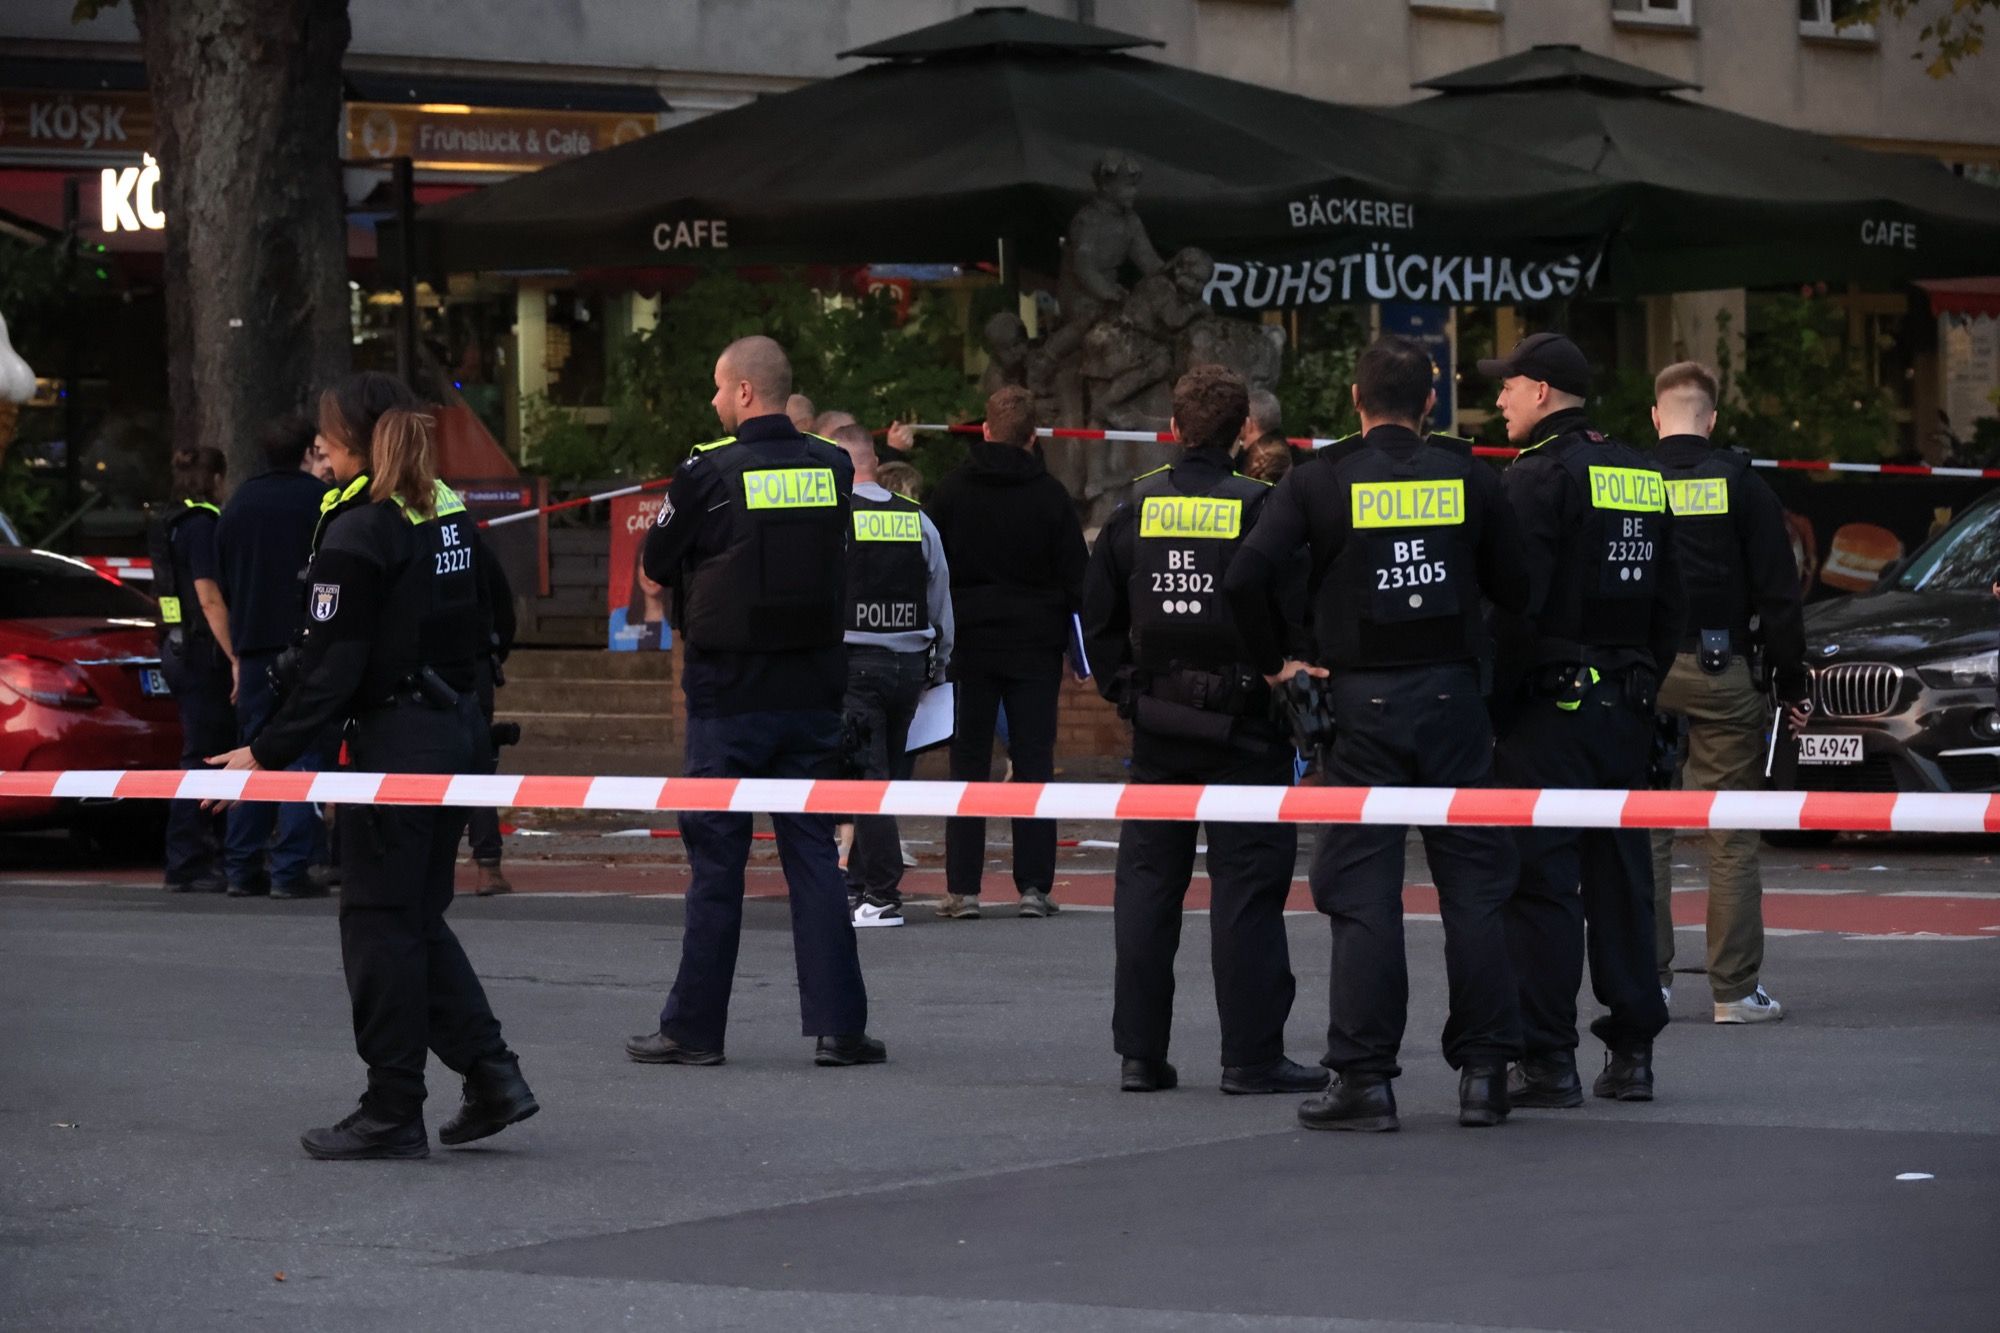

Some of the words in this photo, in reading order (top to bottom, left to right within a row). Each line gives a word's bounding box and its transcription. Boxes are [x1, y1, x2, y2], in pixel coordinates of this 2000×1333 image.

[29, 96, 127, 149] KÖŞK
[526, 128, 540, 153] &
[101, 151, 165, 232] KÖ
[1288, 194, 1415, 230] BÄCKEREI
[652, 219, 729, 252] CAFE
[1860, 218, 1917, 250] CAFE
[1201, 241, 1602, 309] RÜHSTÜCKHAUS
[747, 471, 834, 505] POLIZEI
[1595, 473, 1663, 507] POLIZEI
[1671, 482, 1724, 513] LIZEI
[1145, 503, 1236, 533] POLIZEI
[1358, 486, 1460, 521] POLIZEI
[441, 523, 461, 547] BE
[856, 514, 920, 538] POLIZEI
[1622, 517, 1644, 538] BE
[435, 547, 471, 575] 23227
[1168, 550, 1196, 570] BE
[1393, 539, 1426, 563] BE
[1607, 541, 1654, 562] 23220
[1151, 573, 1214, 593] 23302
[1376, 561, 1447, 590] 23105
[856, 602, 917, 628] POLIZEI
[1819, 737, 1860, 758] 4947
